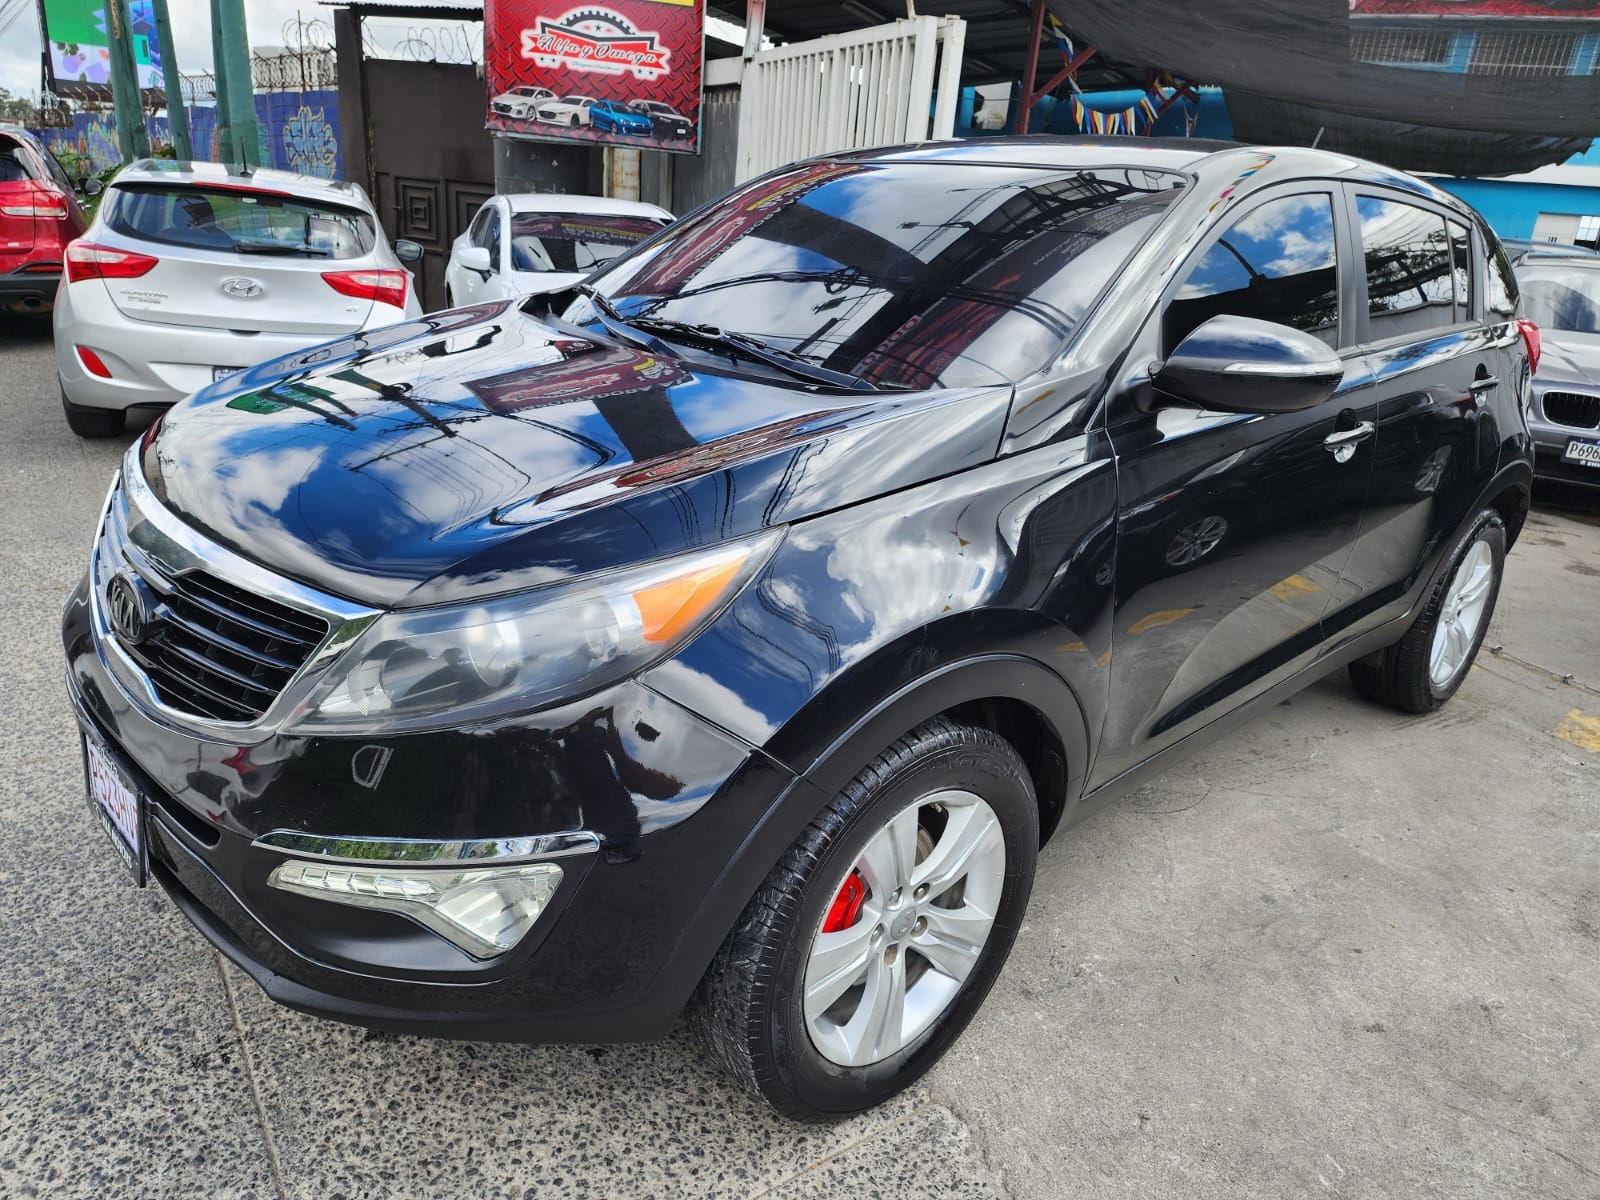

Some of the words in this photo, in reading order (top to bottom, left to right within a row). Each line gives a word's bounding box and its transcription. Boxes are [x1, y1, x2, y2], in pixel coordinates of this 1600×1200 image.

[538, 34, 579, 57] Alfa
[581, 46, 593, 58] y
[595, 43, 657, 65] Omega
[1569, 443, 1600, 459] P696
[111, 581, 136, 637] KIA
